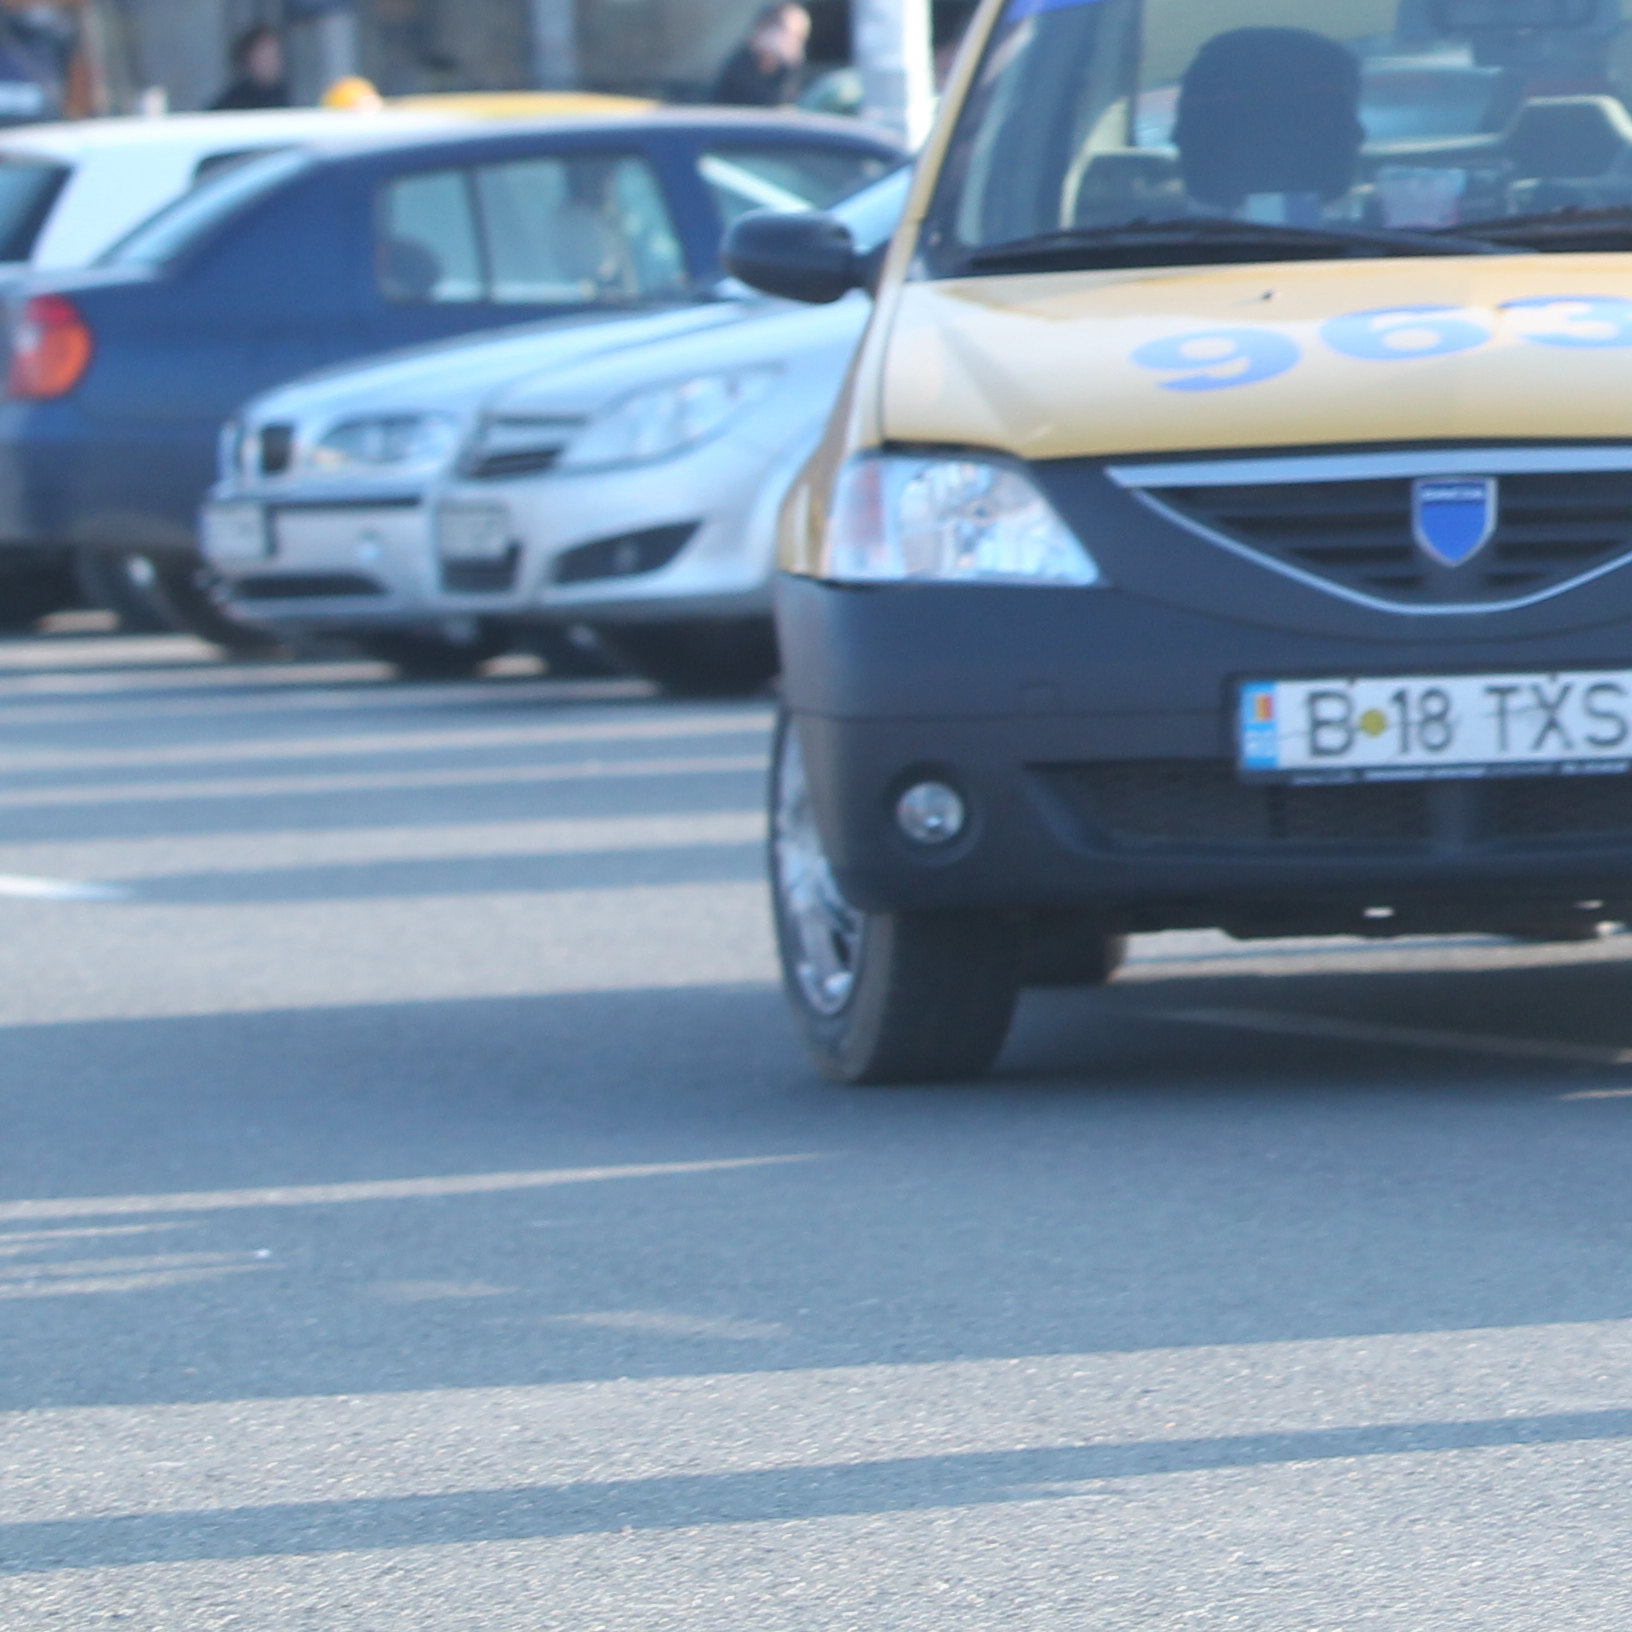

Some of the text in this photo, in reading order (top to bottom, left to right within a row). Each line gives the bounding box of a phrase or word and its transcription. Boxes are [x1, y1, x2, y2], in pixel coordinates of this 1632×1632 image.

[1307, 691, 1354, 757] B
[1390, 687, 1453, 754] 18
[1484, 682, 1628, 751] TXS
